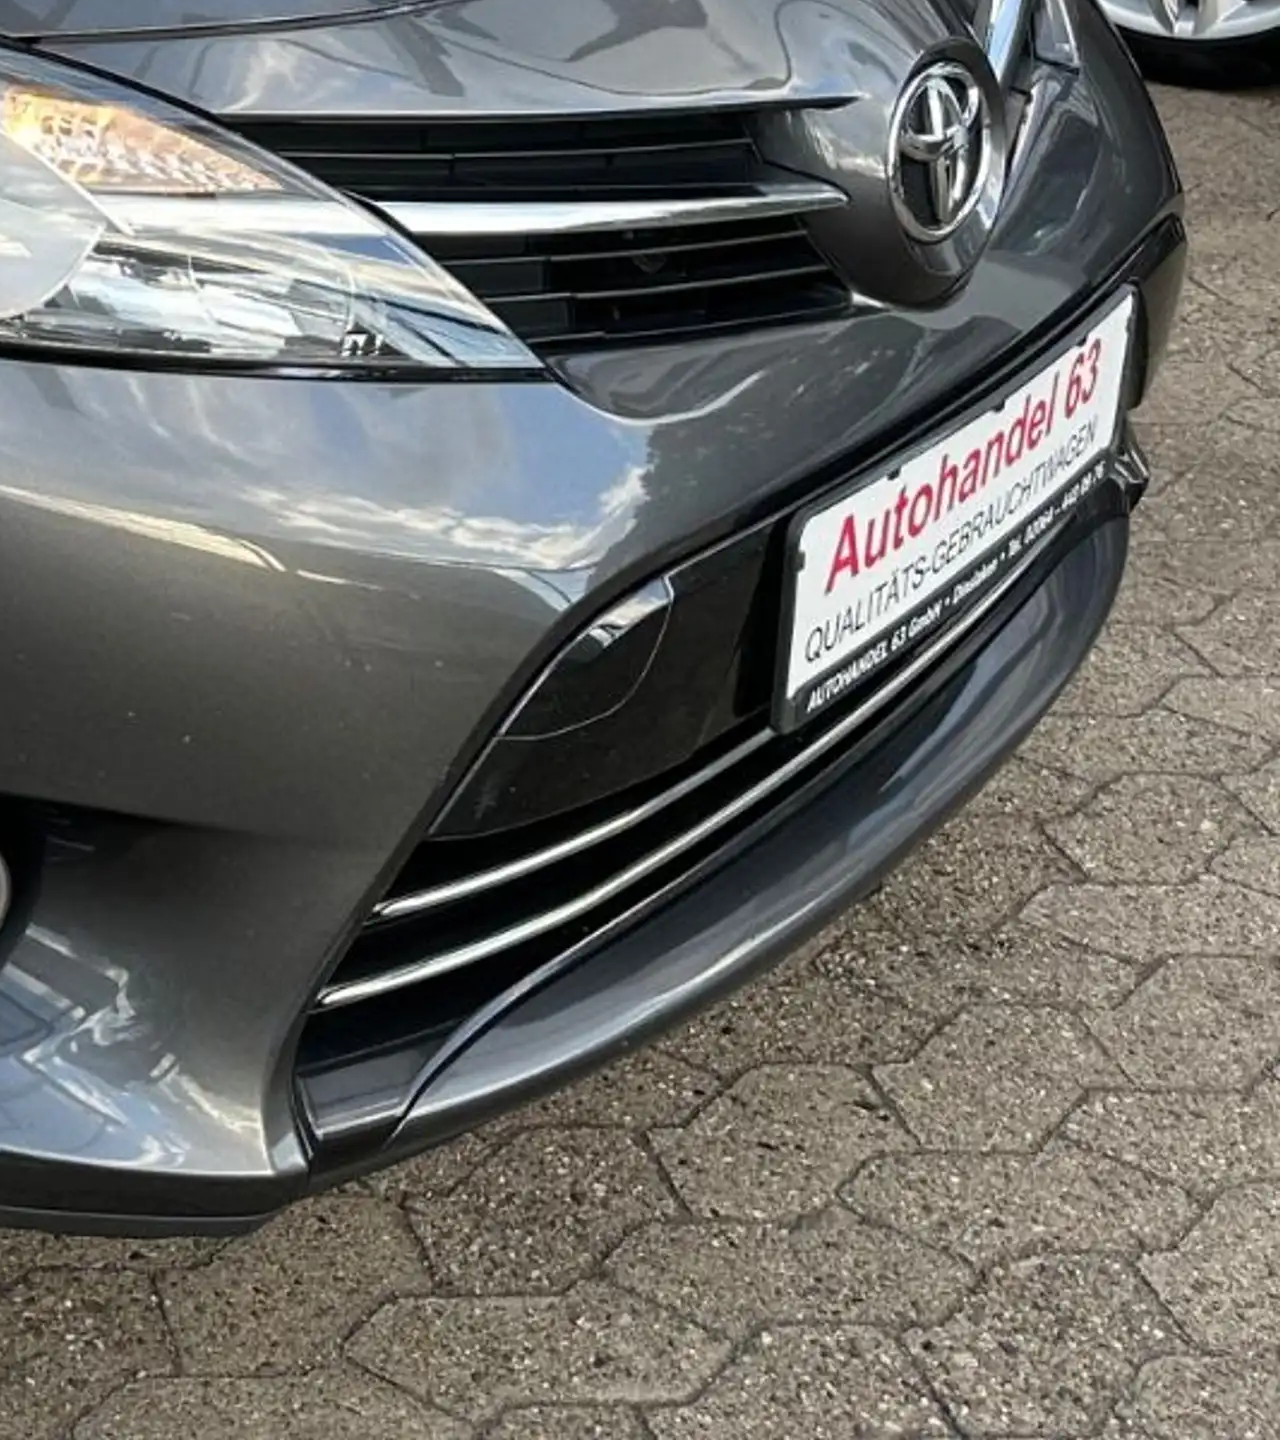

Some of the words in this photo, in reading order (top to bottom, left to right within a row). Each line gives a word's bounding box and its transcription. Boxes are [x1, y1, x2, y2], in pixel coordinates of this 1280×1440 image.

[805, 414, 1100, 663] QUALITÄTS-GEBRAUCHTWAGEN
[824, 370, 1061, 596] Autohandel
[1064, 337, 1102, 420] 63
